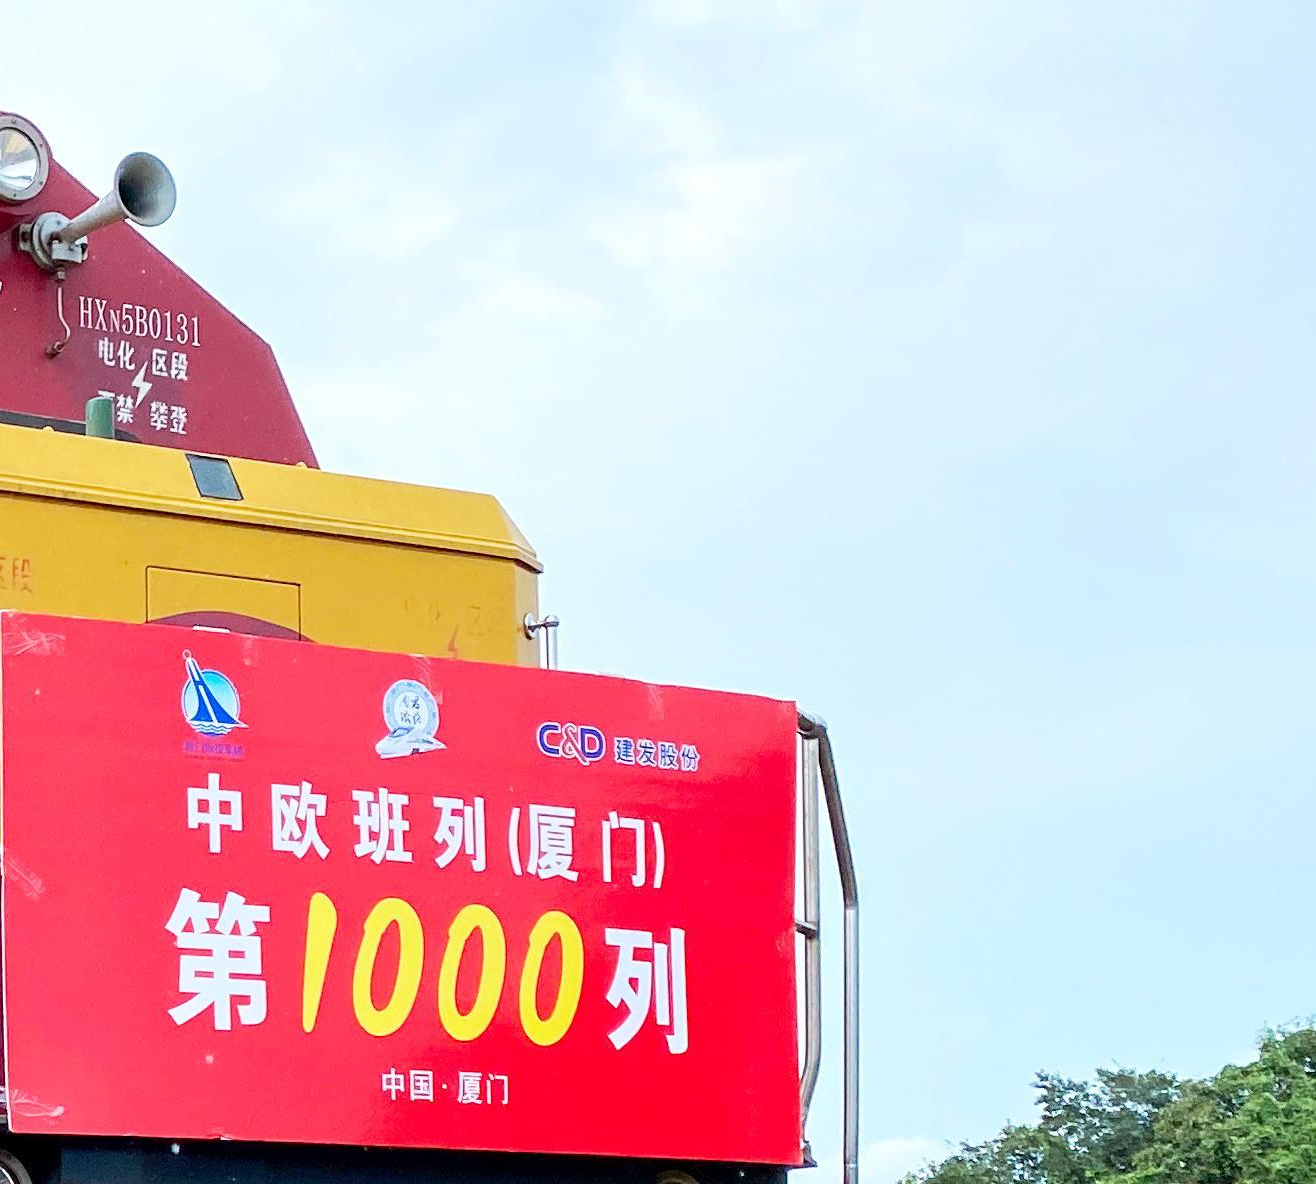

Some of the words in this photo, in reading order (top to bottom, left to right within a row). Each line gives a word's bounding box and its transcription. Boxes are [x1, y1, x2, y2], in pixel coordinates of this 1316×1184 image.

[536, 721, 606, 766] C&D
[614, 736, 701, 773] 建发股份
[185, 772, 666, 889] 中欧班列(厦门)
[164, 887, 689, 1056] 第1000列
